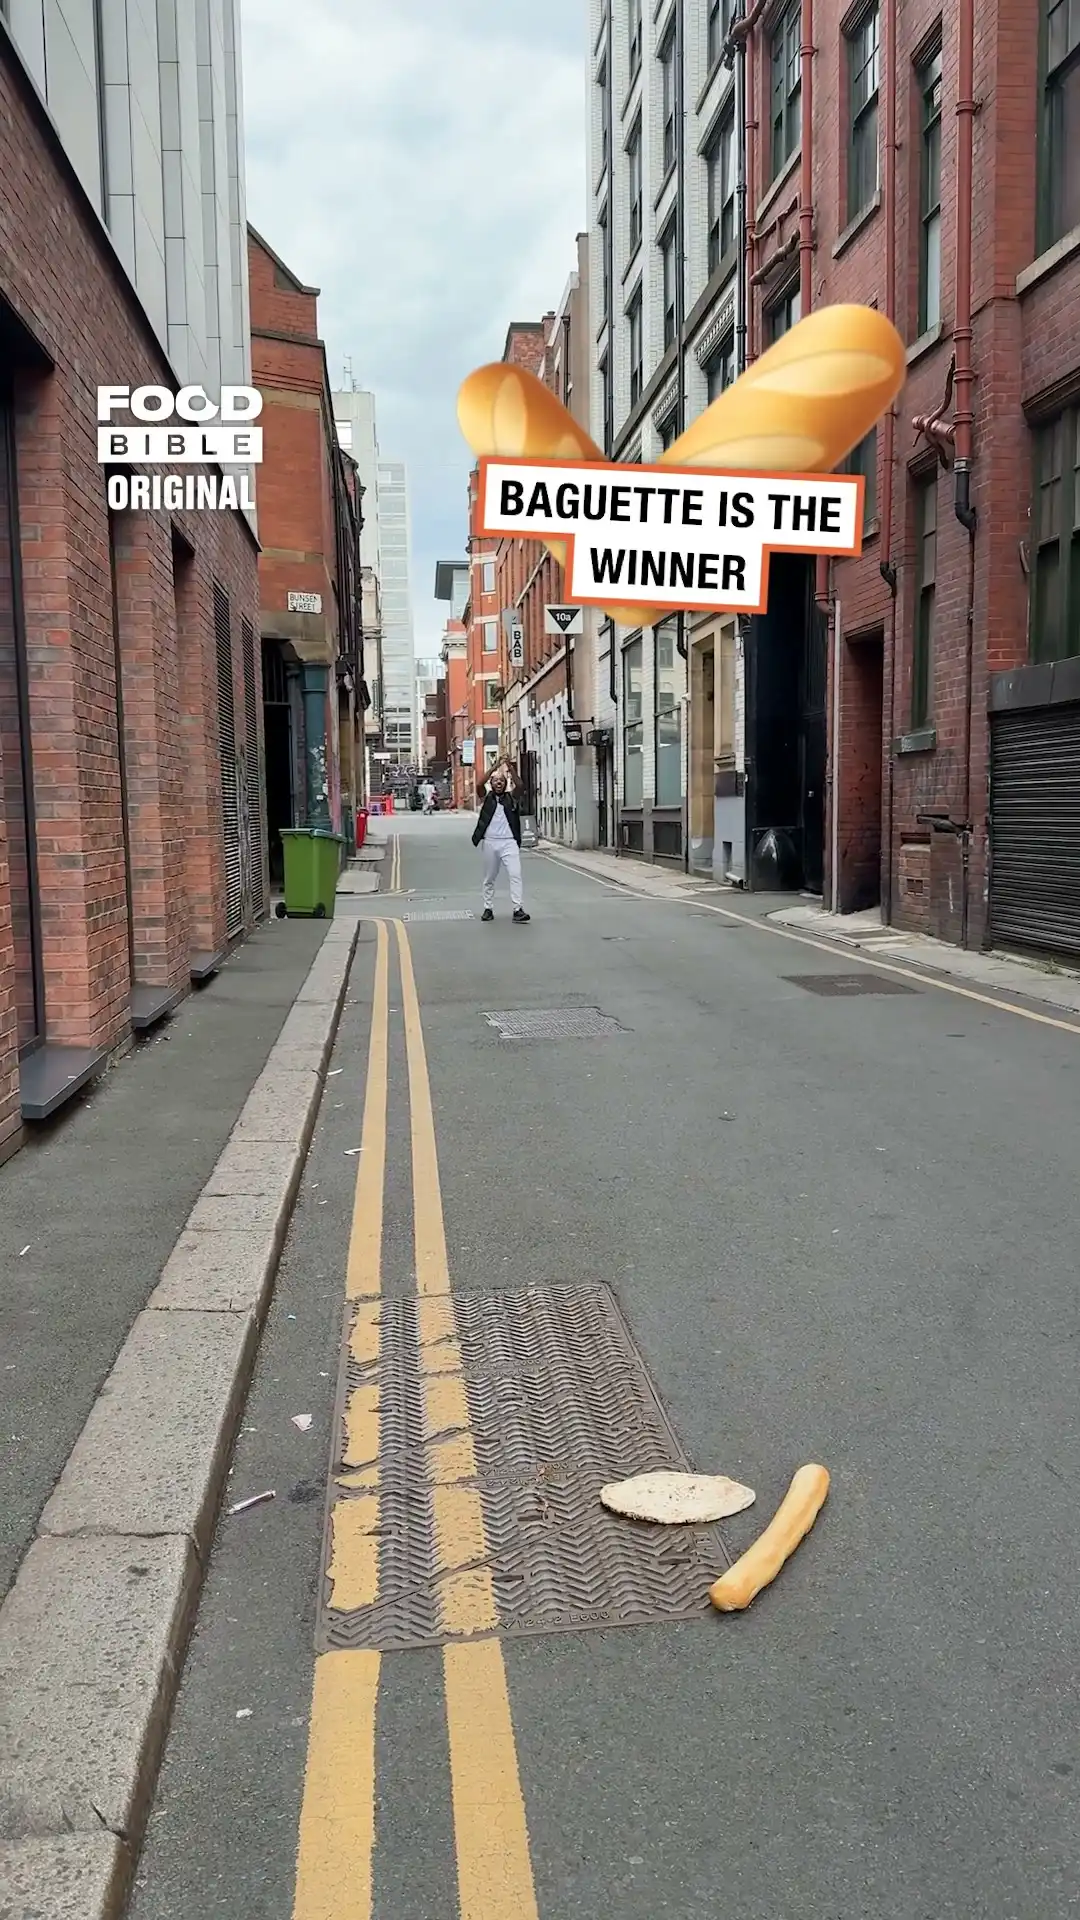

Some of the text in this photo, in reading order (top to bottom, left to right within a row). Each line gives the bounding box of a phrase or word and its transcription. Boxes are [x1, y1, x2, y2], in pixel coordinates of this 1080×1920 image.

[289, 593, 318, 602] BUNSEN
[289, 602, 315, 611] STREET
[555, 613, 571, 622] 10a
[513, 630, 522, 658] BAB
